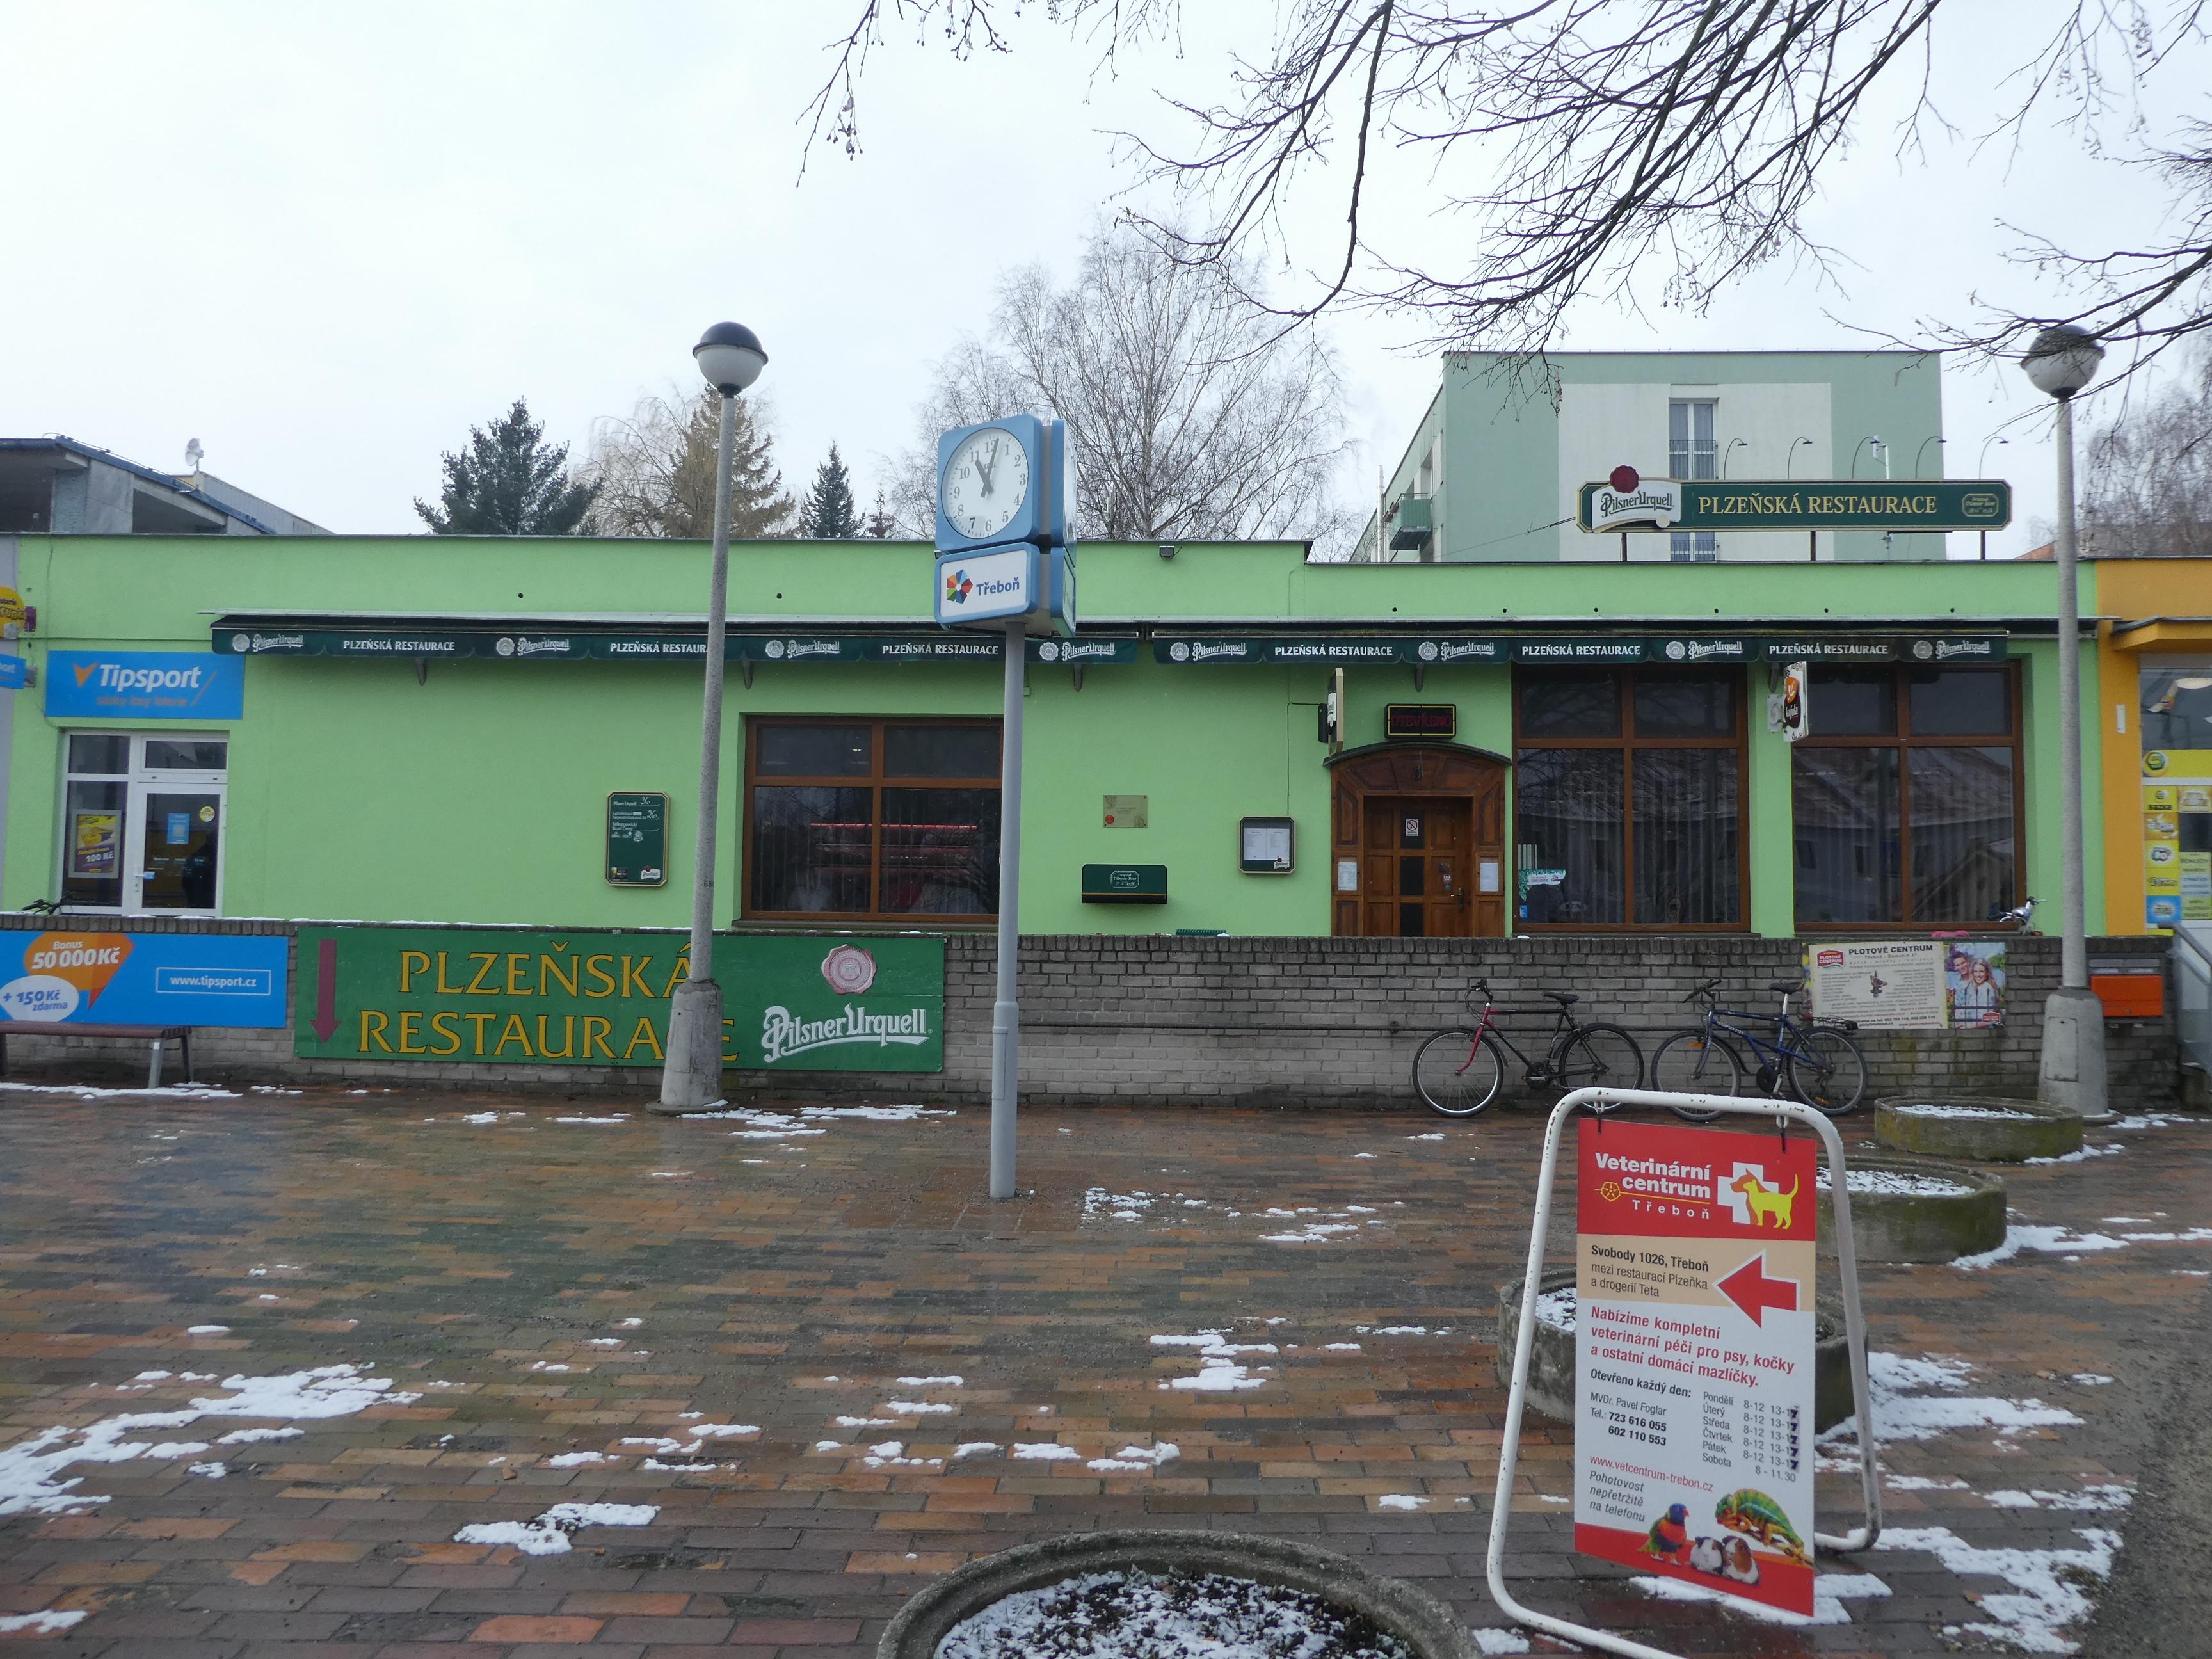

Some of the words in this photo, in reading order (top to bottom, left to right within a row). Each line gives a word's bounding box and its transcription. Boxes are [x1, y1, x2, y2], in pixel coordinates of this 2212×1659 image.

[970, 450, 980, 463] 11
[1005, 444, 1010, 456] 1
[1014, 455, 1021, 467] 2
[959, 466, 970, 480] 10
[1020, 473, 1026, 486] 3
[954, 486, 960, 499] 9
[1013, 493, 1020, 506] 4
[958, 504, 964, 517] 8
[1601, 492, 1639, 518] Pilsner
[1637, 490, 1672, 511] Urquell
[1698, 492, 1802, 514] PLZEŇSKÁ
[1807, 495, 1937, 513] RESTAURACE
[969, 517, 976, 529] 7
[985, 519, 991, 532] 6
[1002, 510, 1009, 523] 5
[976, 577, 1020, 596] Třeboň
[343, 638, 392, 651] PLZEŇSKÁ
[395, 641, 455, 652] RESTAURACE
[518, 637, 544, 656] Pilsner
[543, 637, 569, 651] Urquell
[611, 641, 660, 653] PLZEŇSKÁ
[663, 643, 707, 653] RESTAUR
[787, 640, 815, 659] Pilsner
[814, 641, 840, 655] Urquell
[883, 642, 932, 654] PLZEŇSKÁ
[935, 644, 998, 655] RESTAURACE
[1062, 642, 1089, 661] Pilsner
[1088, 641, 1116, 655] Urquell
[1192, 641, 1222, 661] Pilsner
[1220, 642, 1247, 657] Urquell
[1274, 643, 1325, 656] PLZEŇSKÁ
[1329, 645, 1393, 656] RESTAURACE
[1441, 641, 1470, 661] Pilsner
[1468, 641, 1495, 656] Urquell
[1521, 643, 1573, 655] PLZEŇSKÁ
[1576, 645, 1640, 655] RESTAURACE
[1688, 640, 1717, 660] Pilsner
[1715, 641, 1742, 654] Urquell
[1769, 643, 1821, 655] PLZEŇSKÁ
[1823, 645, 1887, 655] RESTAURACE
[99, 663, 202, 693] Tipsport
[86, 854, 101, 862] 100
[103, 851, 113, 860] Kč
[53, 941, 83, 950] Bonus
[1848, 945, 1888, 955] PLOTOVÉ
[1891, 945, 1933, 953] CENTRUM
[32, 951, 57, 970] 50
[170, 975, 257, 988] www.tipsport.cz
[17, 991, 44, 1005] 150
[47, 990, 61, 1000] Kč
[33, 1002, 68, 1011] zdarma
[358, 1009, 740, 1062] RESTAURAE
[761, 1005, 850, 1064] Pilsner
[844, 1002, 927, 1048] Urquell
[1595, 1152, 1712, 1181] Veterinární
[1622, 1176, 1710, 1199] centrum
[1632, 1199, 1710, 1219] Třeboň
[1591, 1244, 1636, 1263] Svobody
[1639, 1251, 1668, 1267] 1026,
[1671, 1255, 1709, 1272] Třeboň
[1591, 1262, 1614, 1276] mezi
[1617, 1267, 1666, 1284] restaurací
[1669, 1273, 1708, 1290] Plzeňka
[1599, 1278, 1637, 1295] drogerií
[1639, 1283, 1660, 1297] Teta
[1591, 1306, 1649, 1327] Nabízíme
[1655, 1317, 1720, 1340] kompletní
[1591, 1327, 1660, 1349] veterinární
[1664, 1336, 1692, 1354] péči
[1697, 1345, 1719, 1359] pro
[1724, 1350, 1749, 1367] psy,
[1754, 1353, 1795, 1374] kočky
[1591, 1347, 1598, 1356] a
[1602, 1347, 1644, 1365] ostatní
[1647, 1354, 1694, 1374] domácí
[1698, 1365, 1758, 1388] mazlíčky.
[1591, 1368, 1634, 1386] Otevřeno
[1637, 1377, 1667, 1394] každý
[1669, 1384, 1691, 1398] den:
[1590, 1391, 1613, 1406] MVDr.
[1616, 1397, 1639, 1411] Pavel
[1640, 1401, 1667, 1416] Foglar
[1703, 1391, 1734, 1406] Pondělí
[1743, 1400, 1765, 1412] 8-12
[1591, 1407, 1607, 1419] Tel.:
[1608, 1411, 1626, 1423] 723
[1628, 1415, 1646, 1427] 616
[1649, 1418, 1667, 1432] 055
[1703, 1402, 1725, 1418] Úterý
[1743, 1413, 1765, 1425] 8-12
[1608, 1425, 1626, 1437] 602
[1629, 1429, 1646, 1441] 110
[1649, 1433, 1667, 1447] 553
[1703, 1416, 1730, 1430] Středa
[1743, 1425, 1765, 1437] 8-12
[1703, 1426, 1733, 1443] Čtvrtek
[1743, 1438, 1765, 1450] 8-12
[1703, 1440, 1726, 1454] Pátek
[1743, 1450, 1765, 1463] 8-12
[1590, 1455, 1713, 1493] www.vetcentrum-trebon.cz
[1702, 1452, 1731, 1467] Sobota
[1755, 1465, 1761, 1475] 8
[1771, 1470, 1796, 1482] 11.30
[1589, 1470, 1644, 1493] Pohotovost
[1590, 1485, 1644, 1507] nepřetržitě
[1590, 1500, 1601, 1511] na
[1605, 1503, 1646, 1523] telefonu
